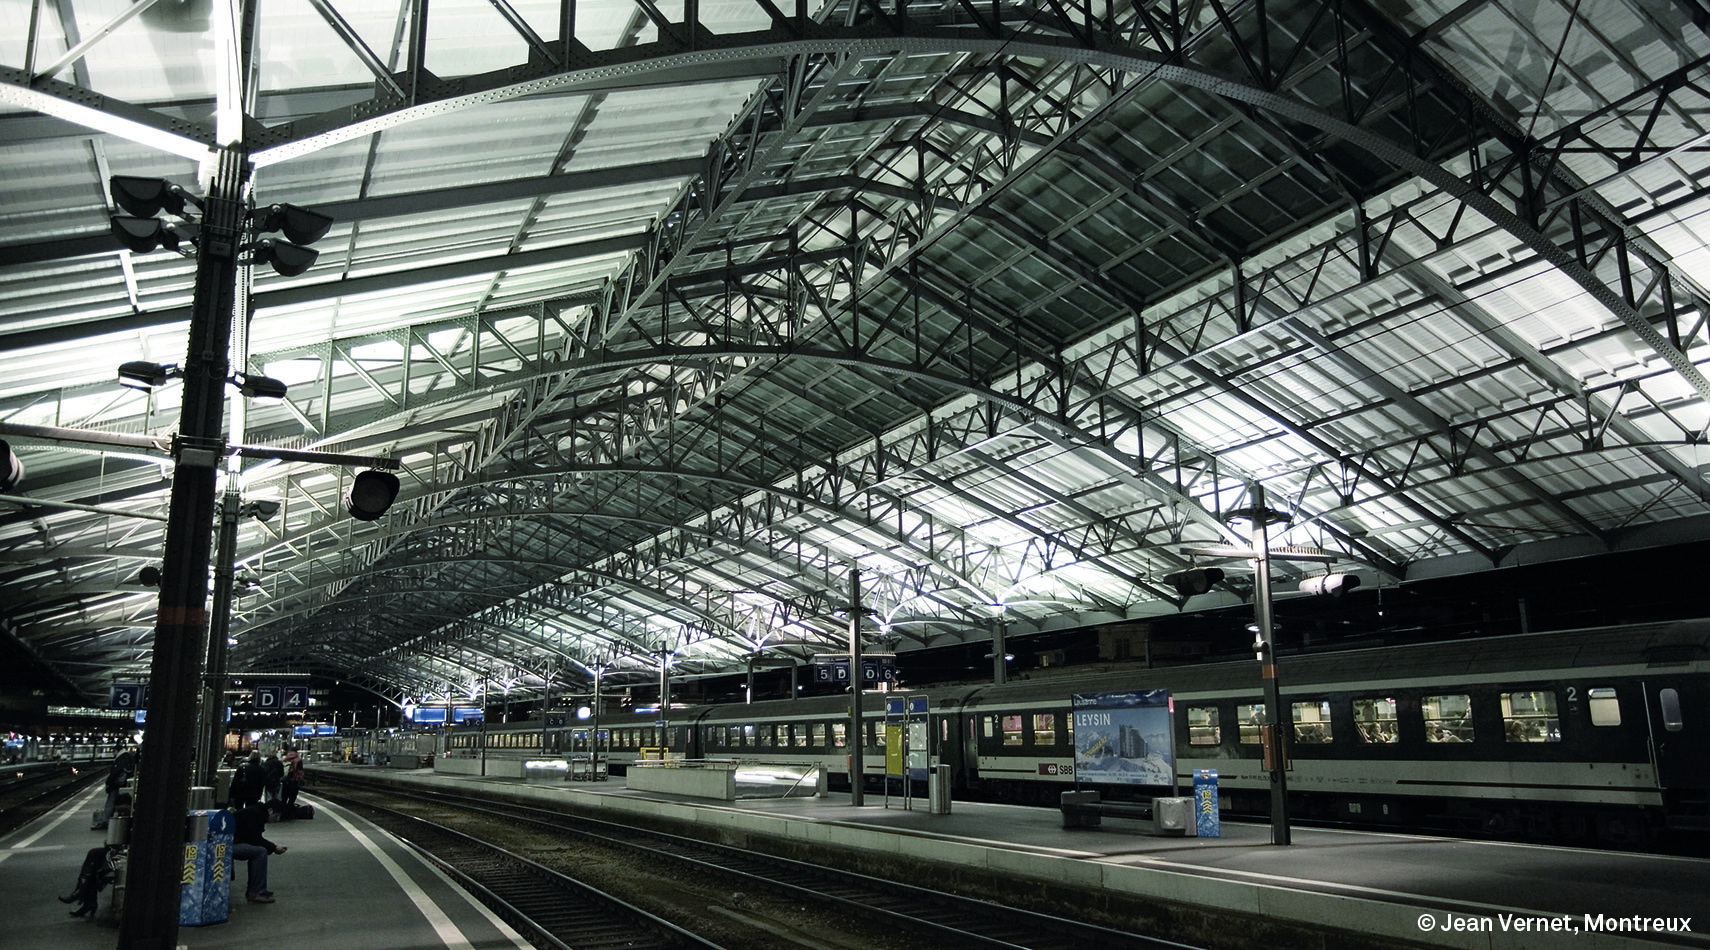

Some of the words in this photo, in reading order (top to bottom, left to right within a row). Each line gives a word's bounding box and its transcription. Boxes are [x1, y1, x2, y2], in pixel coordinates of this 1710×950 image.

[820, 669, 828, 680] 5
[866, 669, 875, 679] D
[884, 669, 892, 680] 6
[118, 692, 131, 706] 3
[262, 693, 274, 706] D
[289, 693, 301, 706] 4
[1566, 686, 1578, 702] 2
[1076, 713, 1111, 727] LEYSIN
[1059, 764, 1074, 775] SBB
